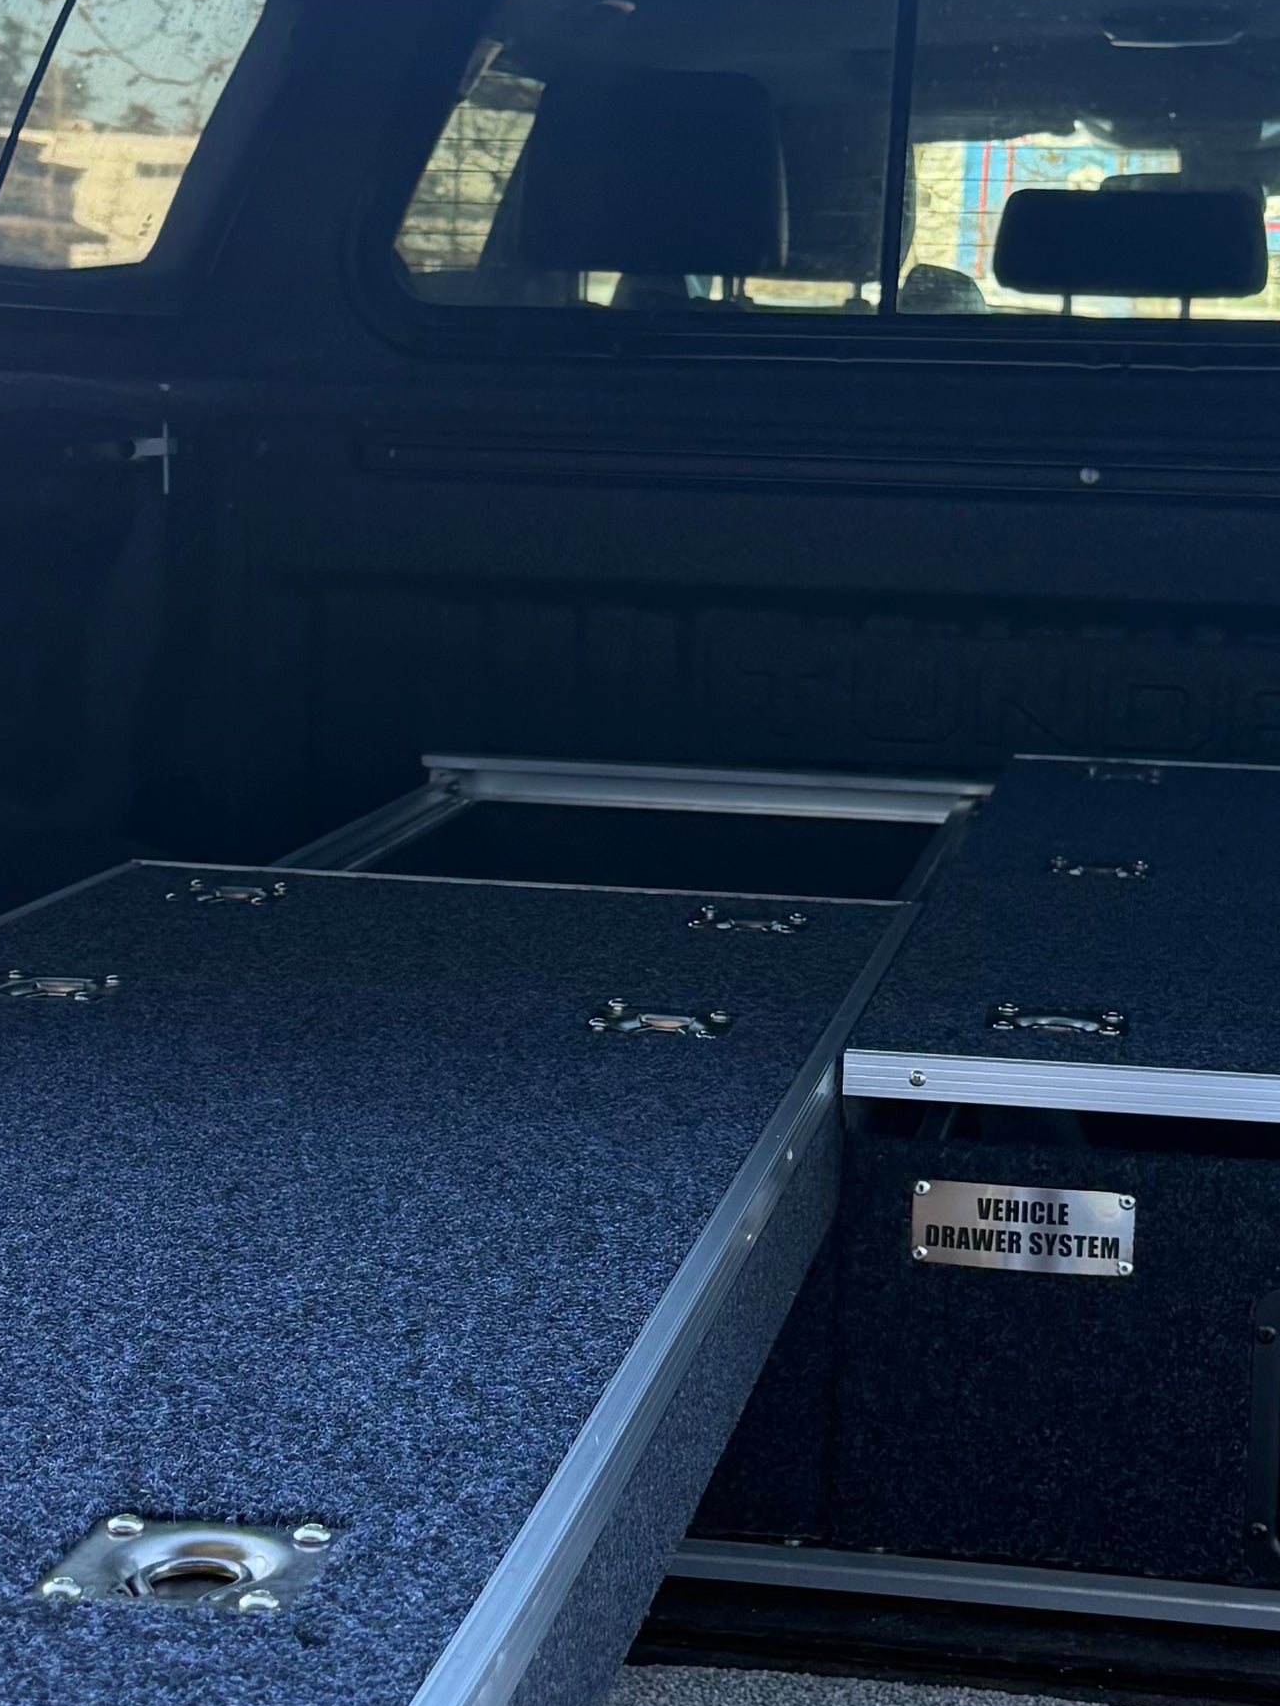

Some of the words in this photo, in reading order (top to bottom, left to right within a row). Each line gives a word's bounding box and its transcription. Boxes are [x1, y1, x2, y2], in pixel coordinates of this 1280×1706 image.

[977, 1197, 1069, 1226] VEHICLE
[925, 1224, 1021, 1254] DRAWER
[1028, 1231, 1120, 1259] SYSTEM
